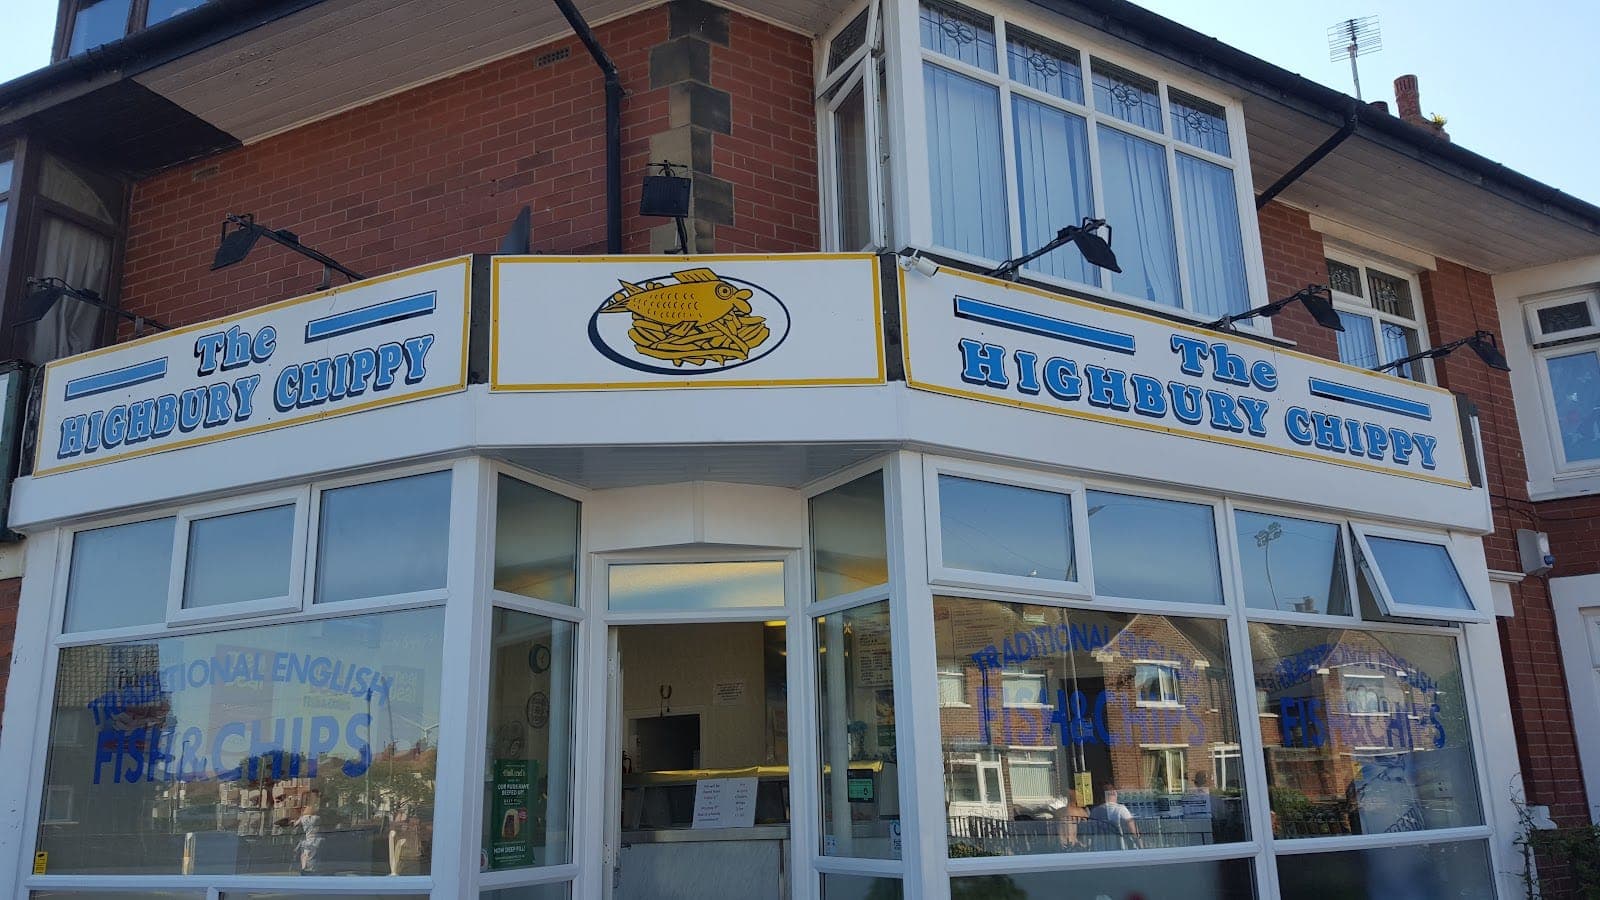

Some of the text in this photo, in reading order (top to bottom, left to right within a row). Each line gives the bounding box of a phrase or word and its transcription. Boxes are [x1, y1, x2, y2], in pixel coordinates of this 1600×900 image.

[194, 325, 278, 377] The
[1170, 333, 1278, 391] The
[57, 333, 435, 460] HIGHBURY CHIPPY
[959, 337, 1437, 470] HIGHBURY CHIPPY
[971, 623, 1112, 674] TRADITIONAL
[87, 654, 265, 726] TRADITIONAL
[271, 651, 393, 705] ENGLISH
